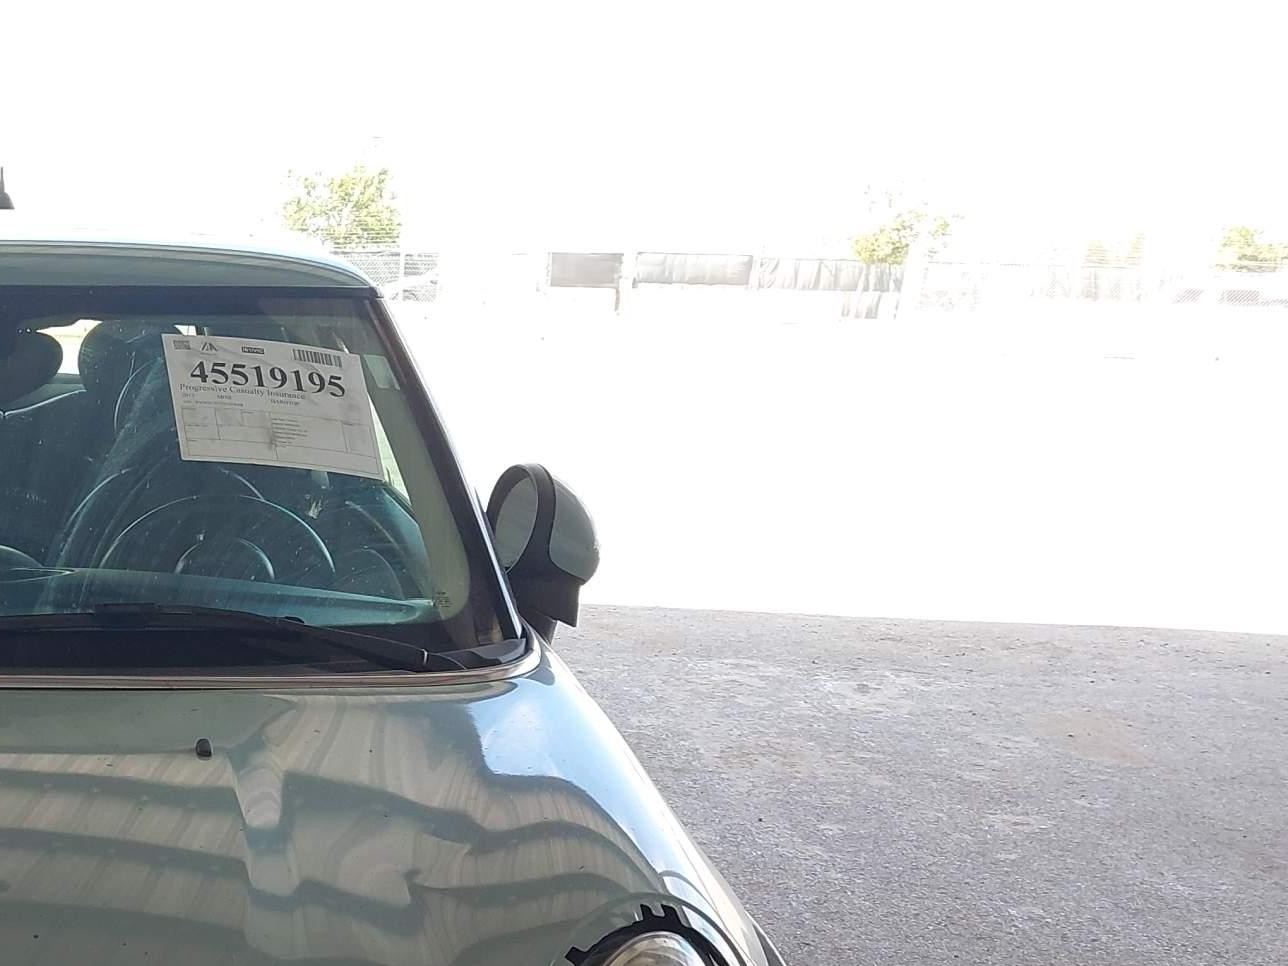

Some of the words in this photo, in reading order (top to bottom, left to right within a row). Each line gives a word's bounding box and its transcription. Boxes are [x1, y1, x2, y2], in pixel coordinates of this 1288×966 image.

[179, 383, 228, 393] Progressive
[229, 387, 265, 397] Casualty
[267, 389, 306, 399] Insurance
[189, 361, 346, 398] 45519195
